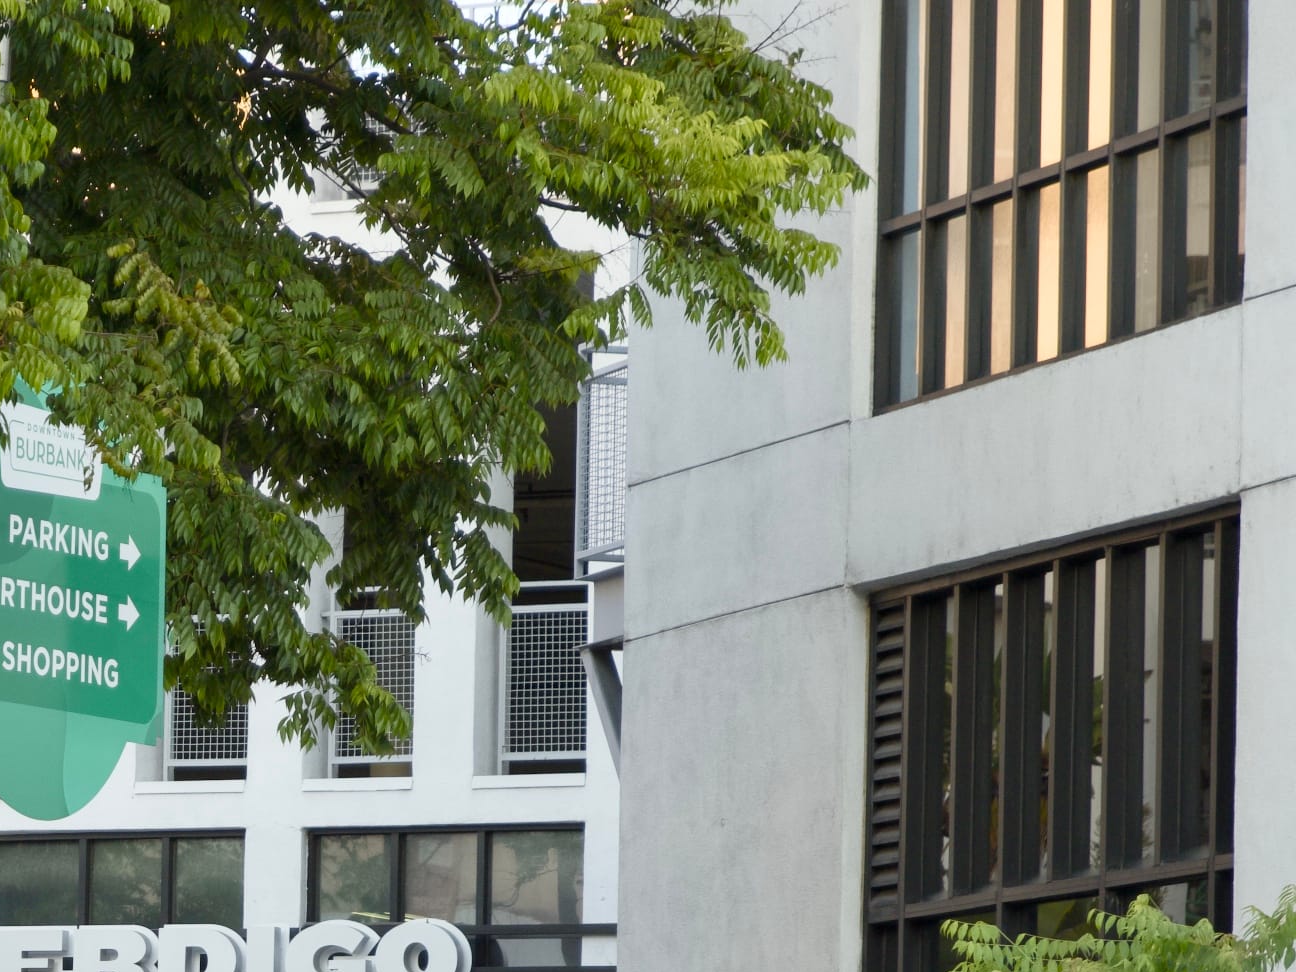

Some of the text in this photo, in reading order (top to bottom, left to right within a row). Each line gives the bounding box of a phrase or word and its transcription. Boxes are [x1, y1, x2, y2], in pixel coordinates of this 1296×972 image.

[27, 423, 75, 441] DOWNTOWN
[16, 436, 86, 471] BURBANK
[8, 514, 109, 561] PARKING
[2, 640, 119, 689] SHOPPING
